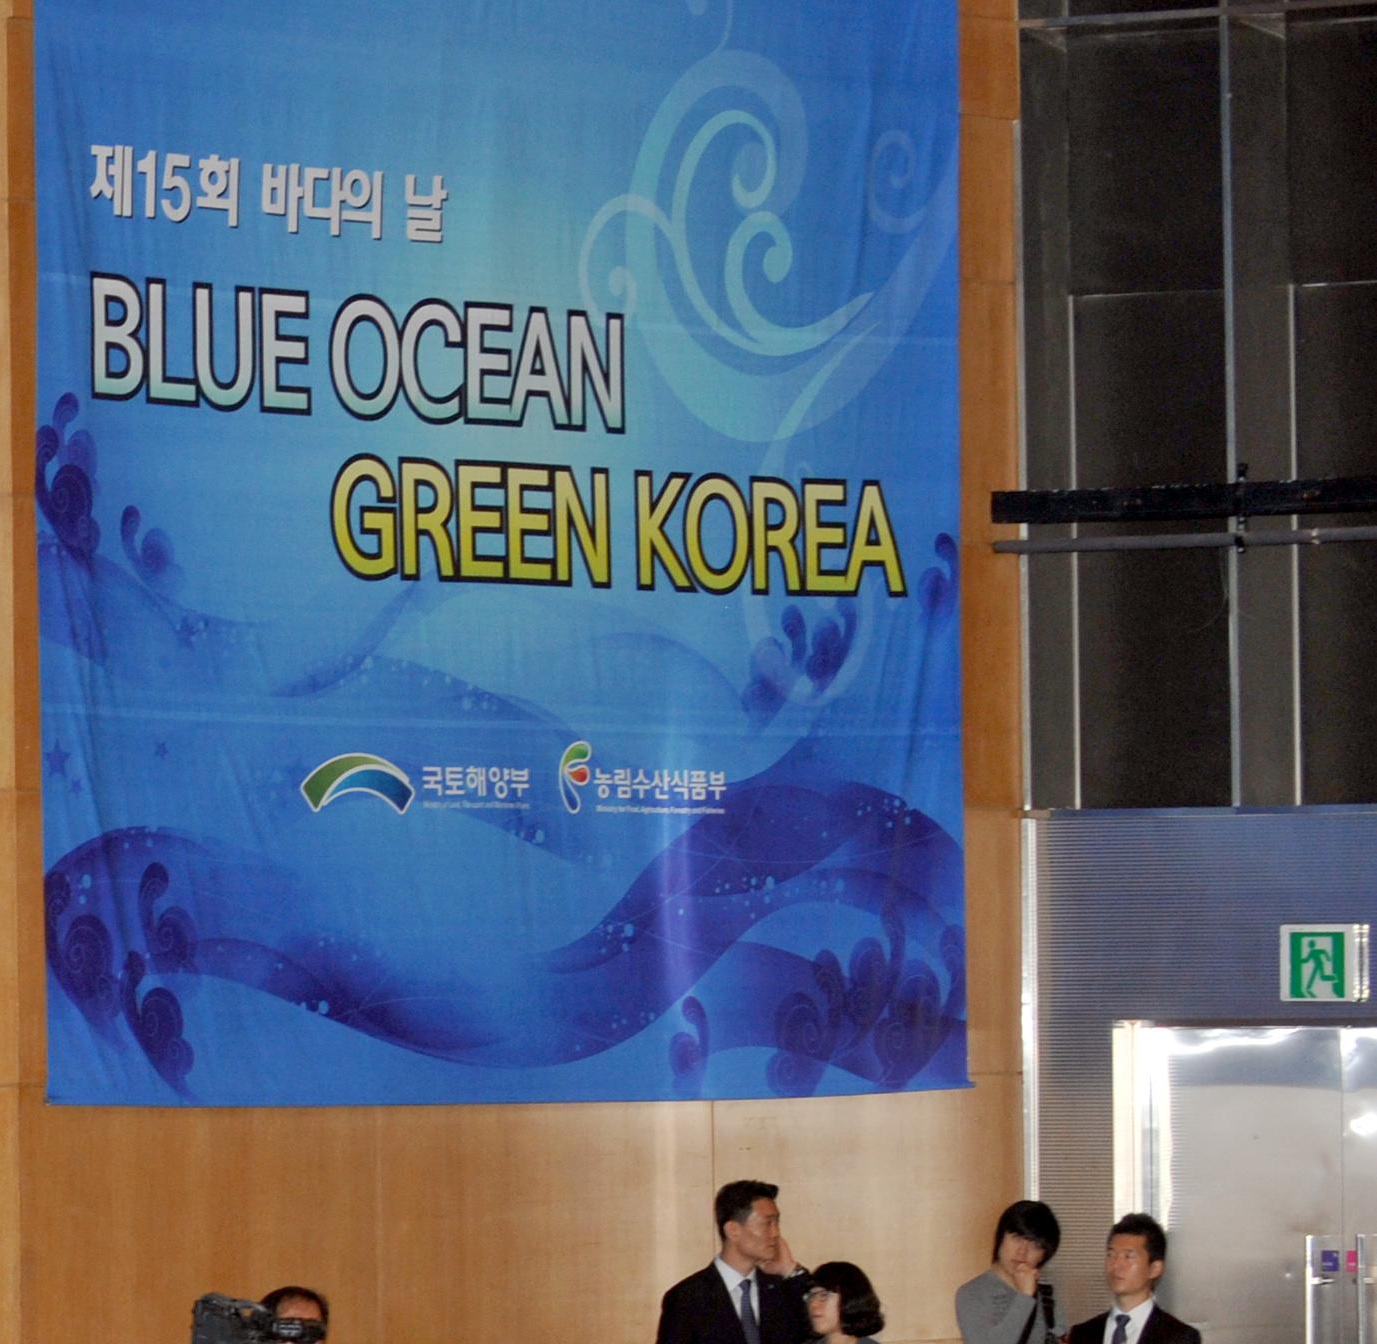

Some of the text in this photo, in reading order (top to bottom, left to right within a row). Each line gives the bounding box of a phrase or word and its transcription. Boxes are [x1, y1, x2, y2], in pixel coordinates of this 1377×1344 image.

[89, 144, 448, 242] 제15회 바다의 날
[88, 270, 626, 434] BLUE OCEAN
[330, 453, 908, 598] GREEN KOREA
[421, 765, 531, 799] 국토해양부
[592, 767, 727, 801] 농림수산식품부
